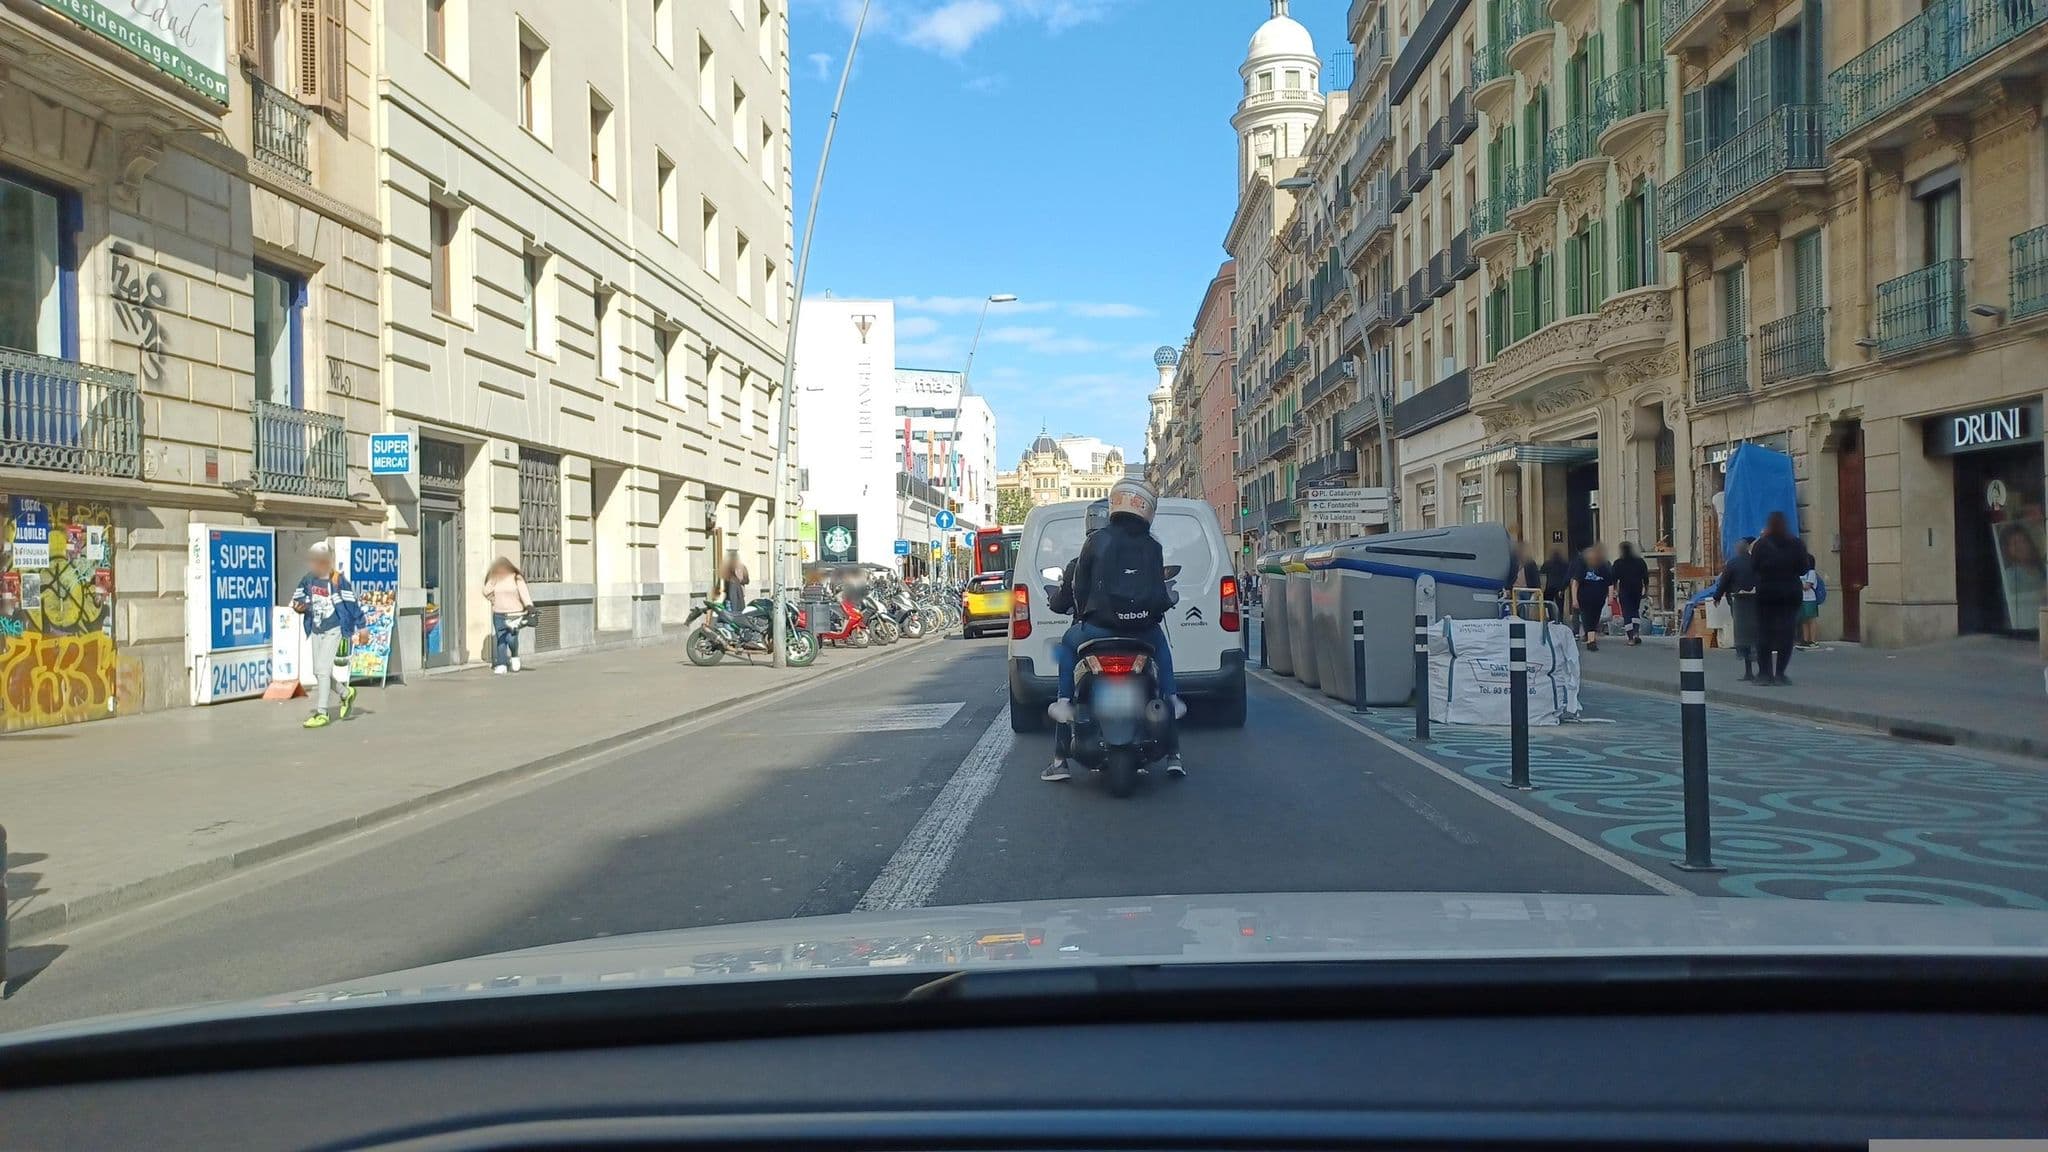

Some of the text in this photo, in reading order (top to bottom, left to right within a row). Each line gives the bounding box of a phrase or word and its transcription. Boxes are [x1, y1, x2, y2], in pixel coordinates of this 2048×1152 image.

[1954, 408, 2020, 446] DRUNI
[374, 440, 408, 453] SUPER
[374, 457, 408, 468] MERCAT
[16, 528, 47, 541] ALQUILER
[220, 544, 265, 569] SUPER
[355, 547, 395, 573] SUPER
[217, 575, 269, 600] MERCAT
[221, 606, 266, 637] PELAI
